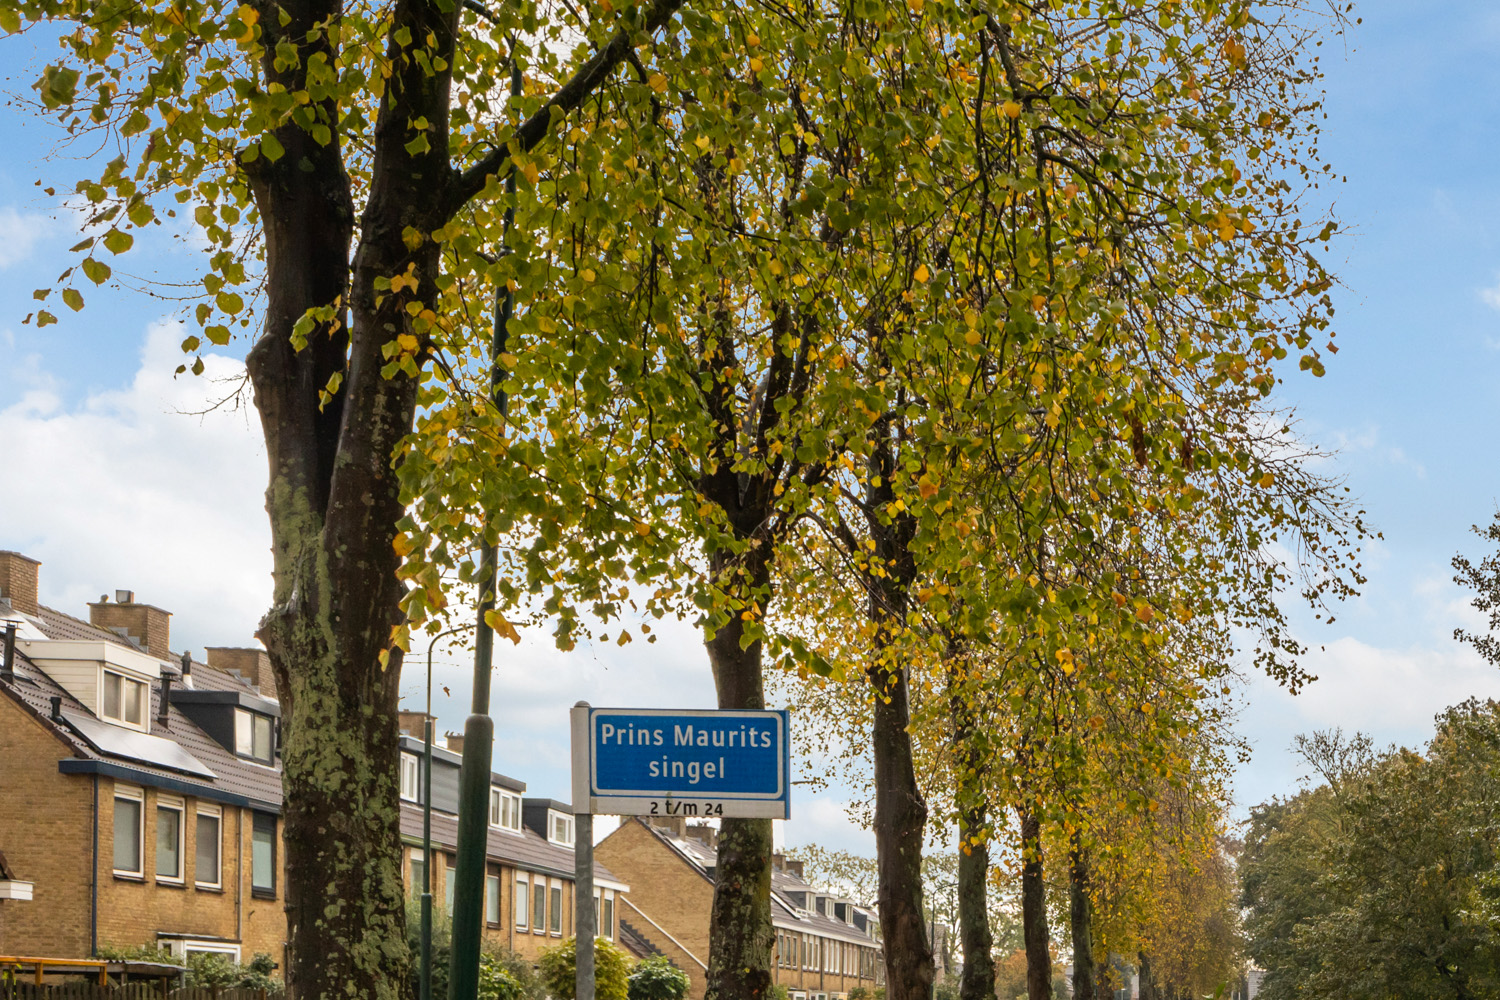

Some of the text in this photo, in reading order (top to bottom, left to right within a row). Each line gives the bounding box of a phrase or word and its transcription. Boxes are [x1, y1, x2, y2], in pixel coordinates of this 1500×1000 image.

[601, 723, 771, 748] Prins Maurits
[649, 755, 724, 784] singel
[650, 800, 723, 815] 2 t/m 24
